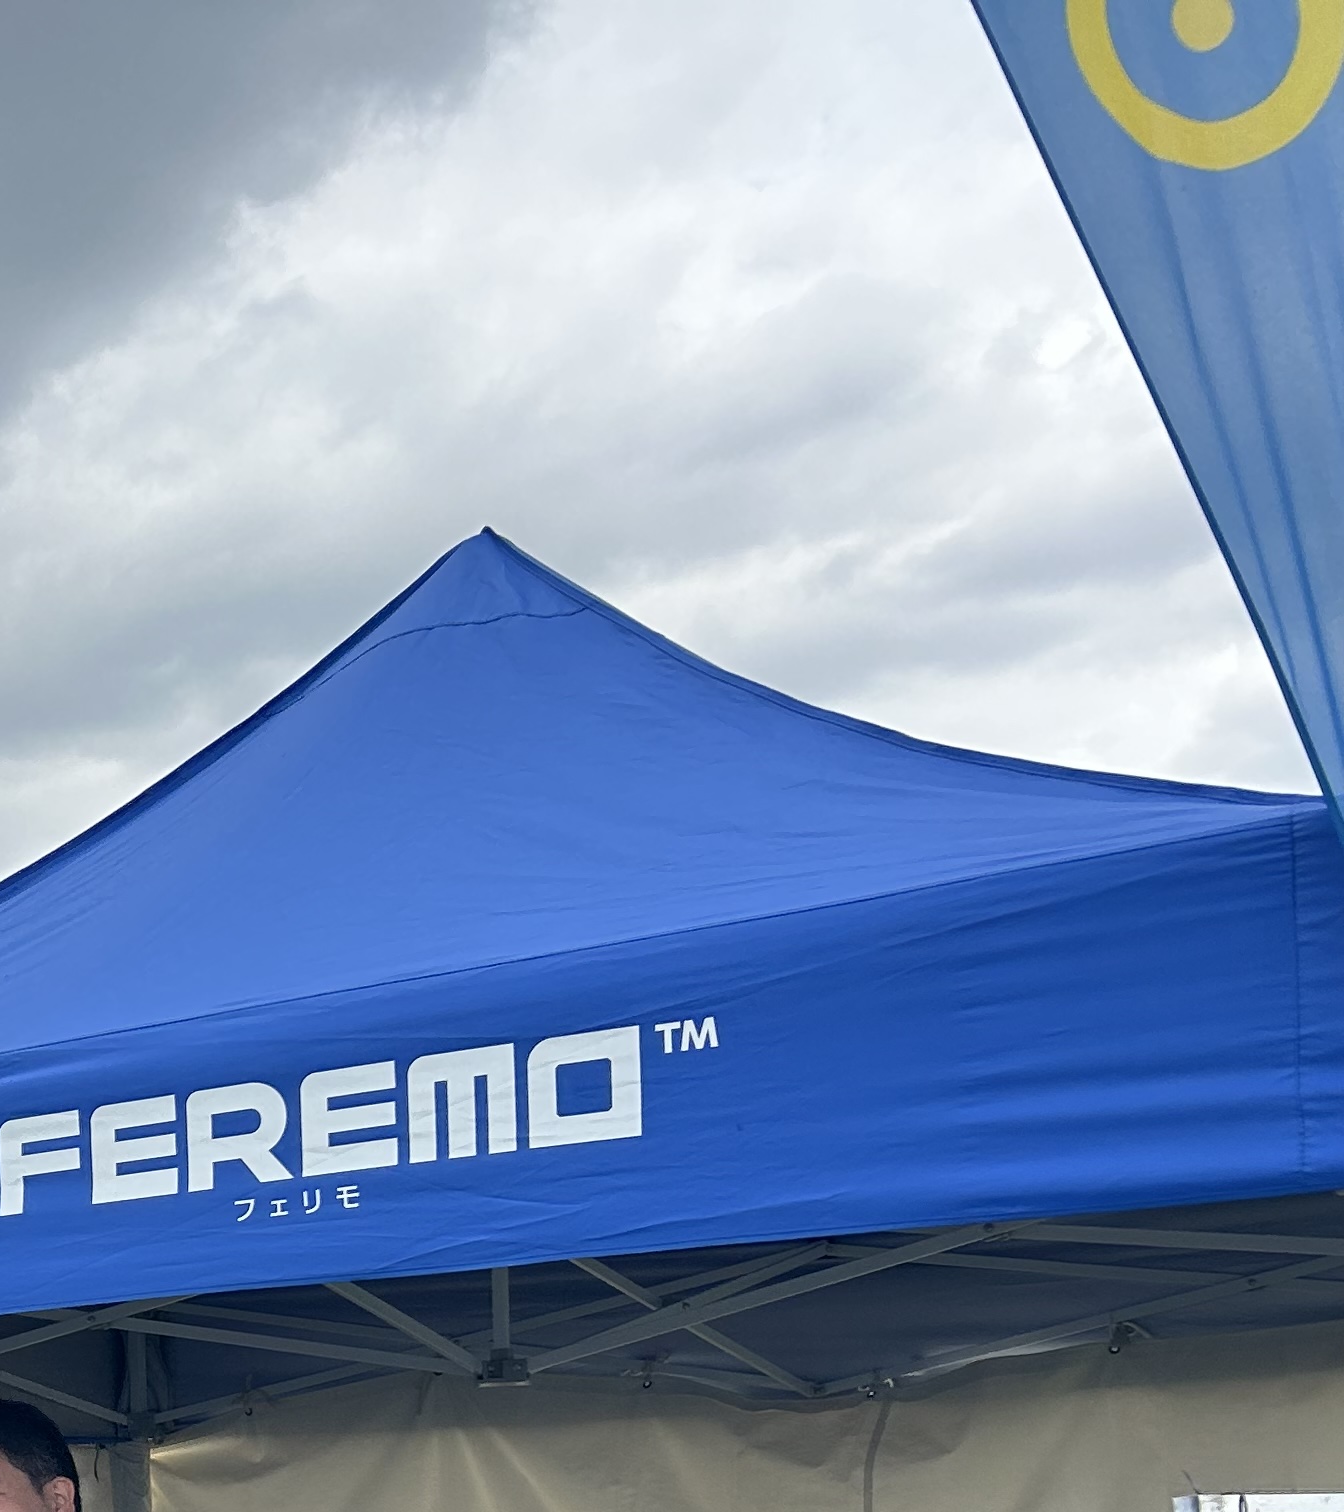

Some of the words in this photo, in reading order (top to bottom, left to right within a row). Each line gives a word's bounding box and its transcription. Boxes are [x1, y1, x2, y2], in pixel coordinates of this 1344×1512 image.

[0, 1025, 642, 1217] FEREMO
[234, 1185, 360, 1222] フェリモ
